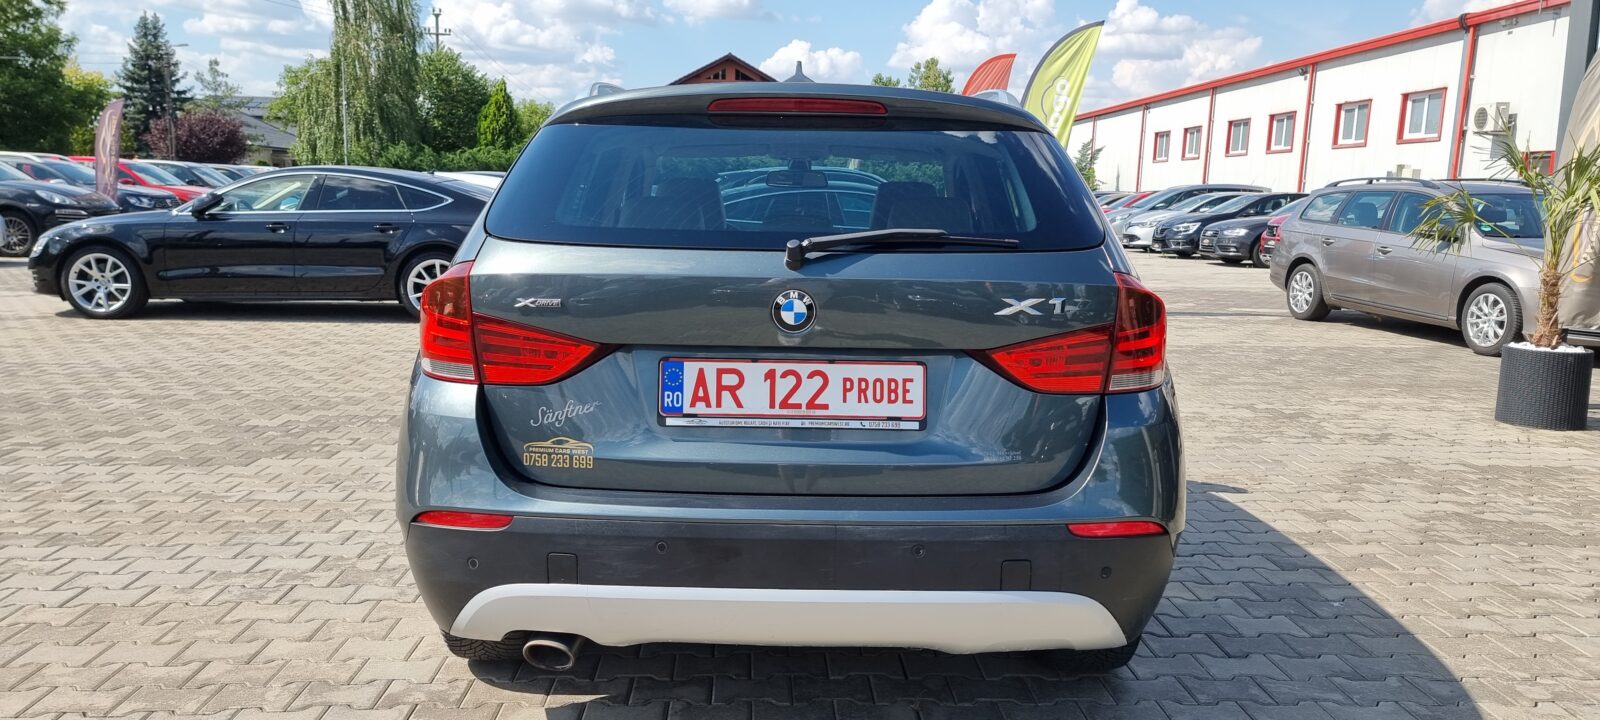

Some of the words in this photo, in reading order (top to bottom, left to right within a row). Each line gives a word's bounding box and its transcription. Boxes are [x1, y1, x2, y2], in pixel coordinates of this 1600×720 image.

[776, 291, 813, 305] BMW
[993, 297, 1067, 316] X1
[664, 391, 682, 407] RO
[689, 367, 745, 409] AR
[763, 368, 830, 411] 122
[842, 377, 914, 404] PROBE
[523, 452, 548, 467] 0758
[551, 454, 570, 468] 233
[572, 455, 593, 469] 699
